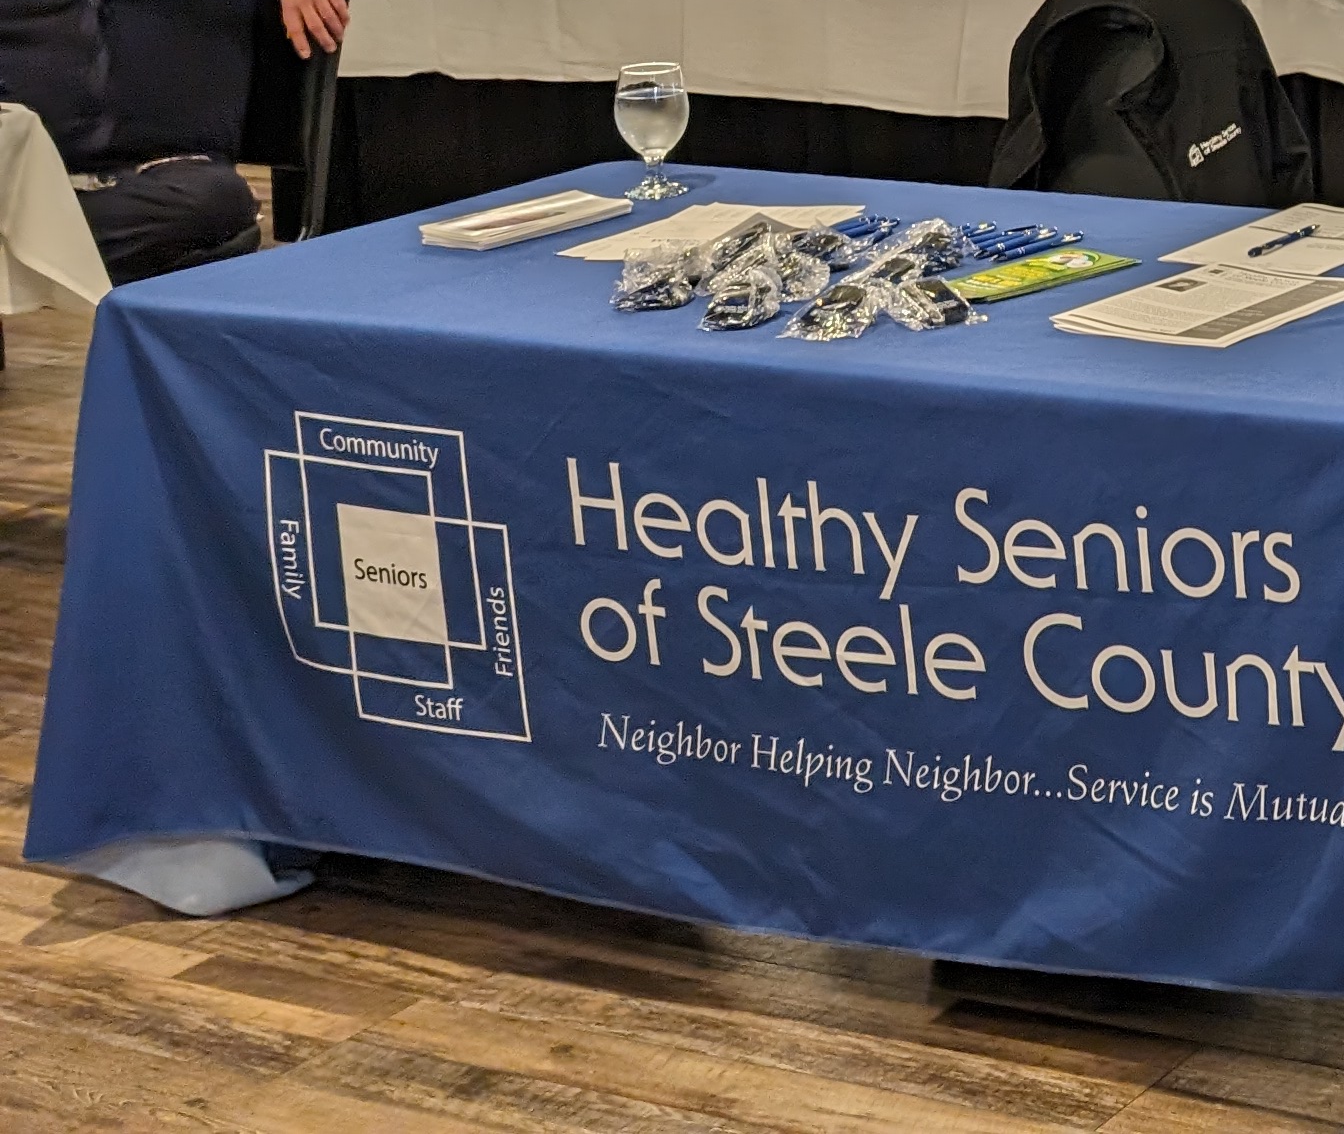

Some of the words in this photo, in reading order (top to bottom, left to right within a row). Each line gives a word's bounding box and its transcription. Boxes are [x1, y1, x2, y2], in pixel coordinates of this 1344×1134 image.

[318, 427, 439, 468] Community
[279, 519, 306, 600] Family
[566, 458, 919, 600] Healthy
[954, 487, 1301, 603] Seniors
[353, 558, 428, 590] Seniors
[486, 586, 514, 677] Friends
[580, 579, 667, 665] of
[698, 586, 987, 700] Steele
[414, 694, 464, 721] Staff
[597, 713, 742, 764] Neighbor
[750, 734, 874, 794] Helping
[1190, 778, 1214, 817] is
